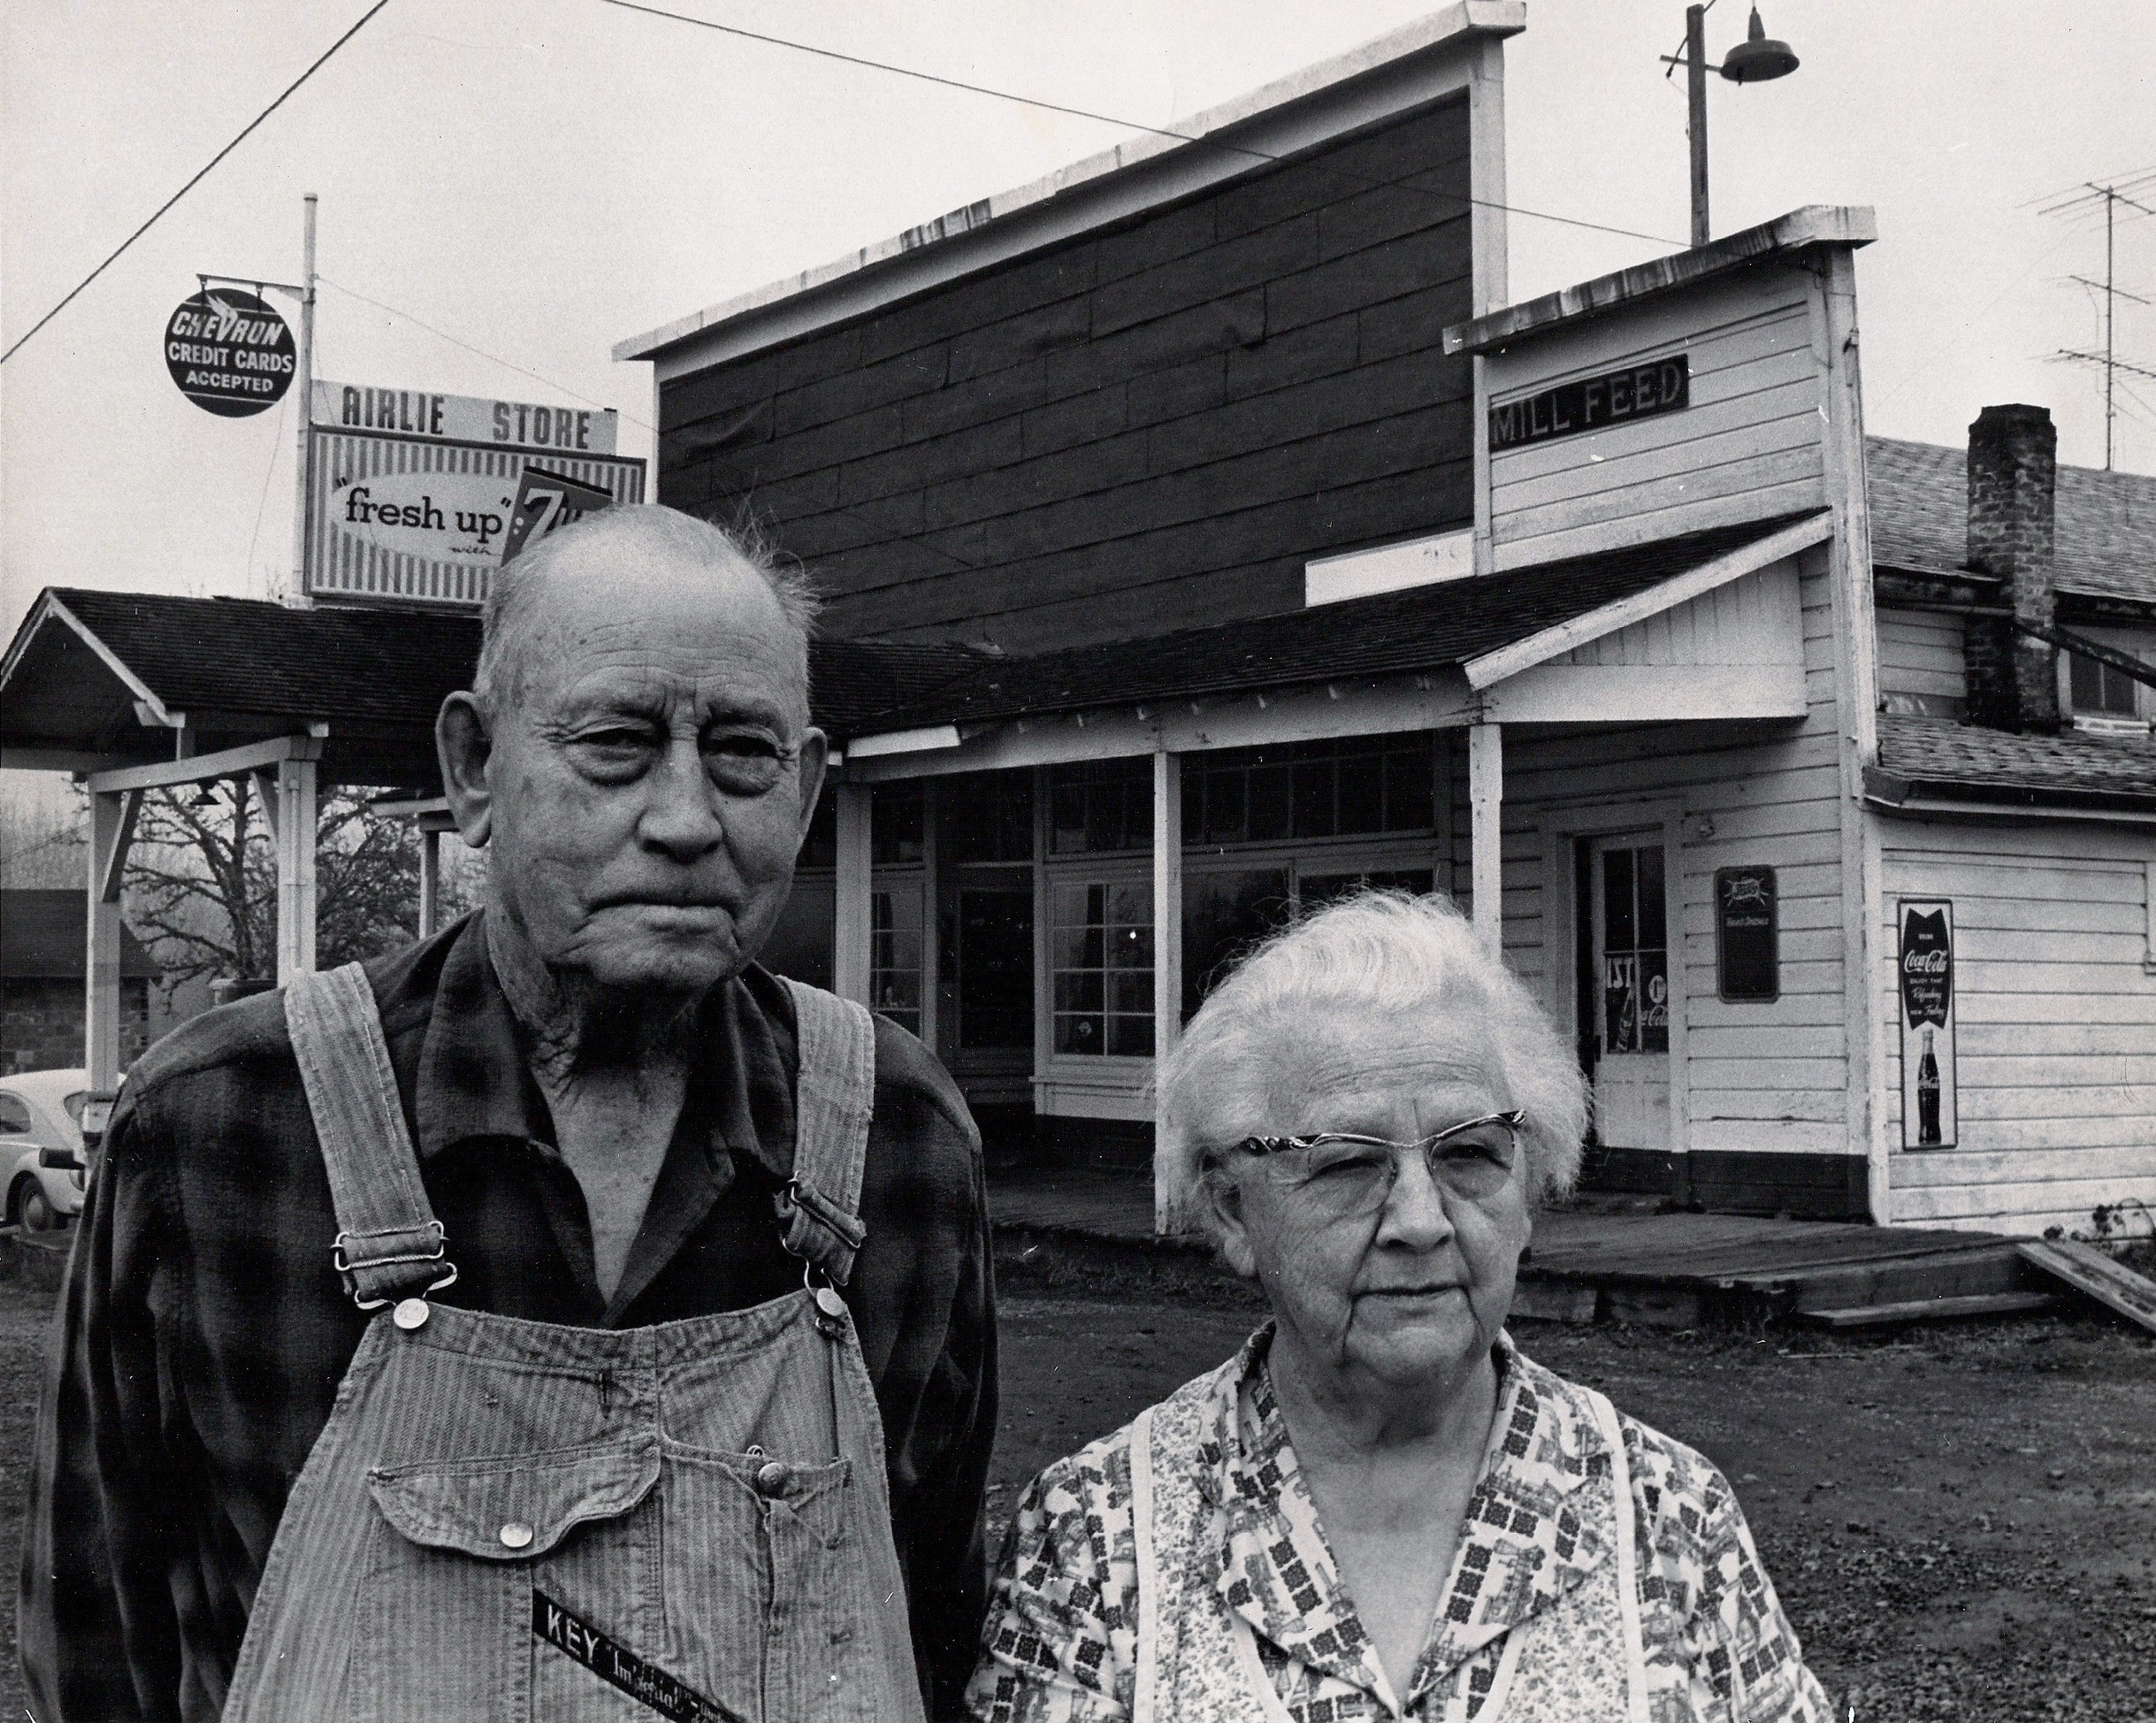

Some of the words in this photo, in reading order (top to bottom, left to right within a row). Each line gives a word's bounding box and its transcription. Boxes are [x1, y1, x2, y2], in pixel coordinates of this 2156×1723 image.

[171, 309, 286, 346] CHEVRON
[167, 341, 230, 367] CREDIT
[234, 349, 294, 374] CARDS
[185, 370, 274, 393] ACCEPTED
[342, 386, 444, 434] AIRLIE
[493, 402, 591, 449] STORE
[1491, 394, 1571, 445] MILL
[1585, 364, 1681, 424] FEED
[547, 1604, 600, 1665] KEY
